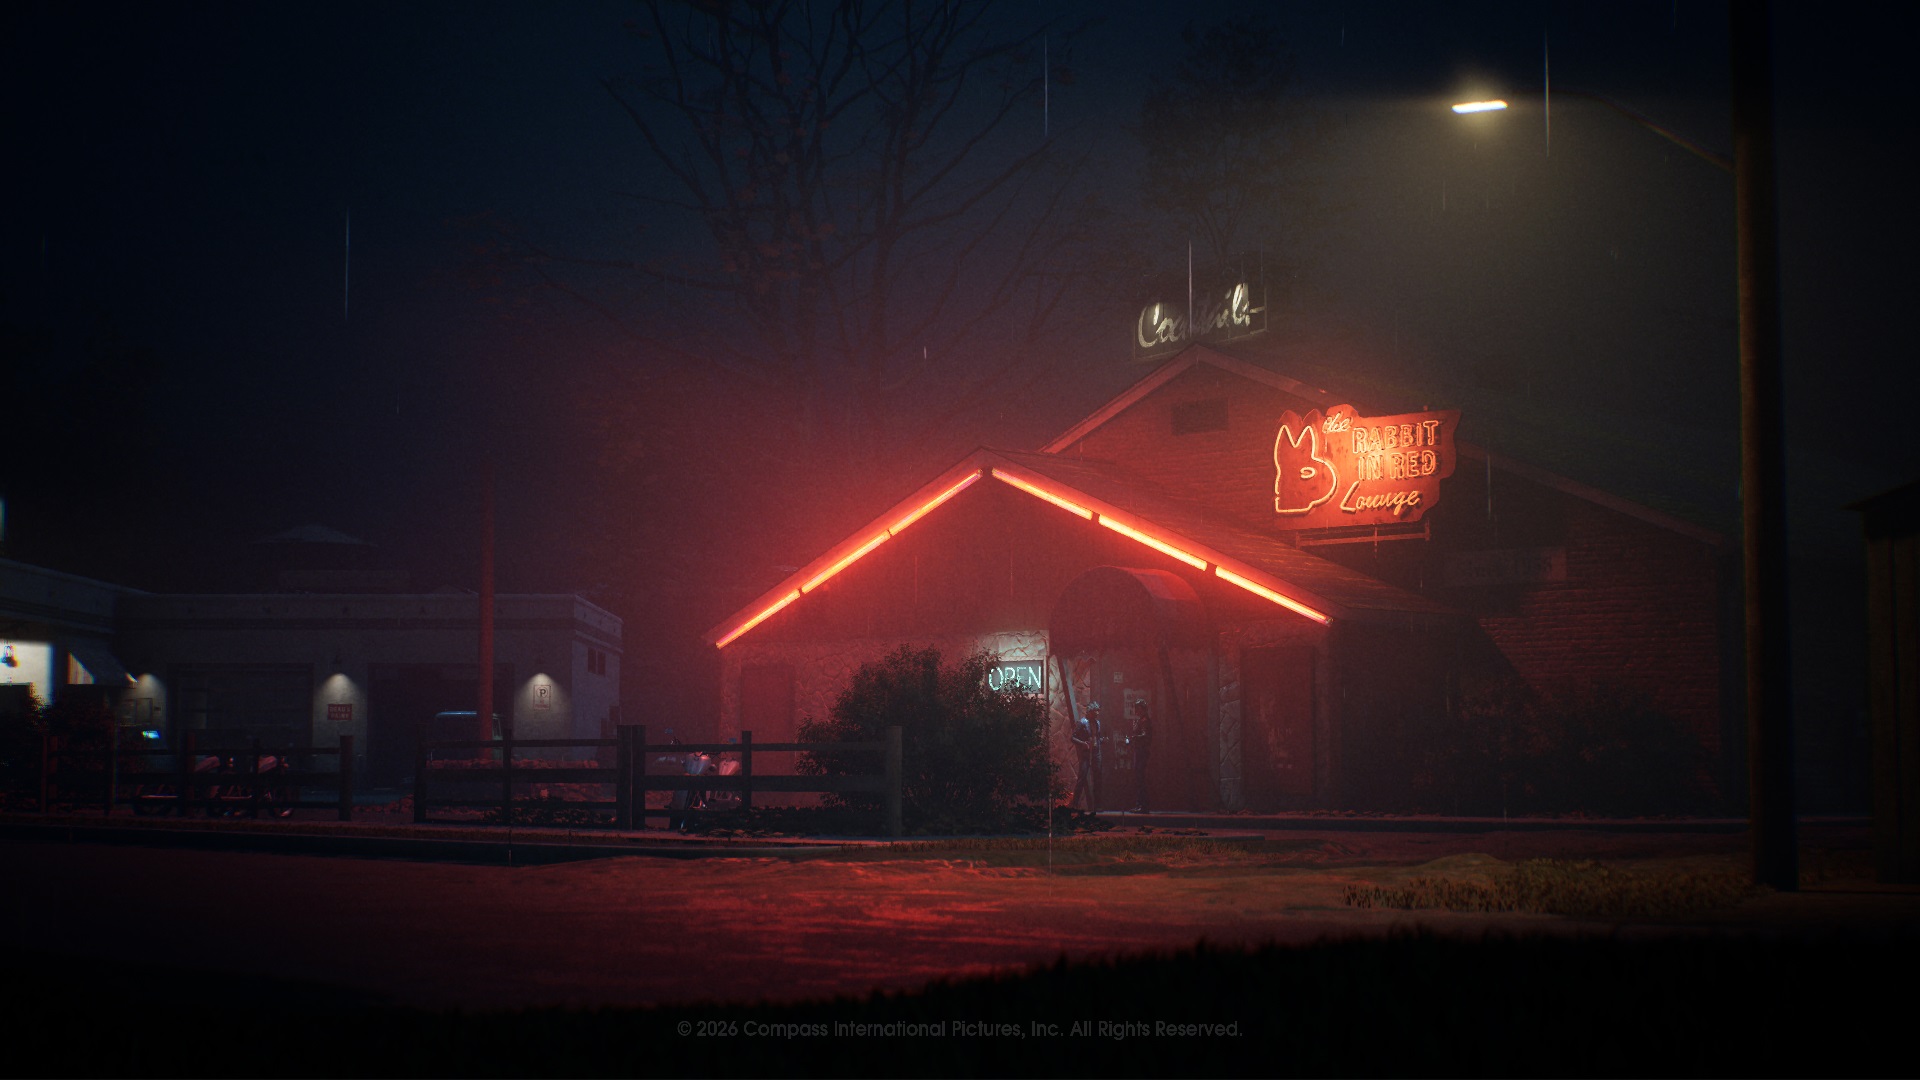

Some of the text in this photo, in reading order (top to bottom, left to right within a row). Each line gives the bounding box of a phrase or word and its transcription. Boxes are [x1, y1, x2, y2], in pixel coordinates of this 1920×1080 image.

[1322, 411, 1353, 434] the
[1352, 420, 1439, 454] RABBIT
[1358, 450, 1437, 481] IN RED
[1340, 480, 1420, 516] Lounge
[988, 665, 1042, 691] OPEN
